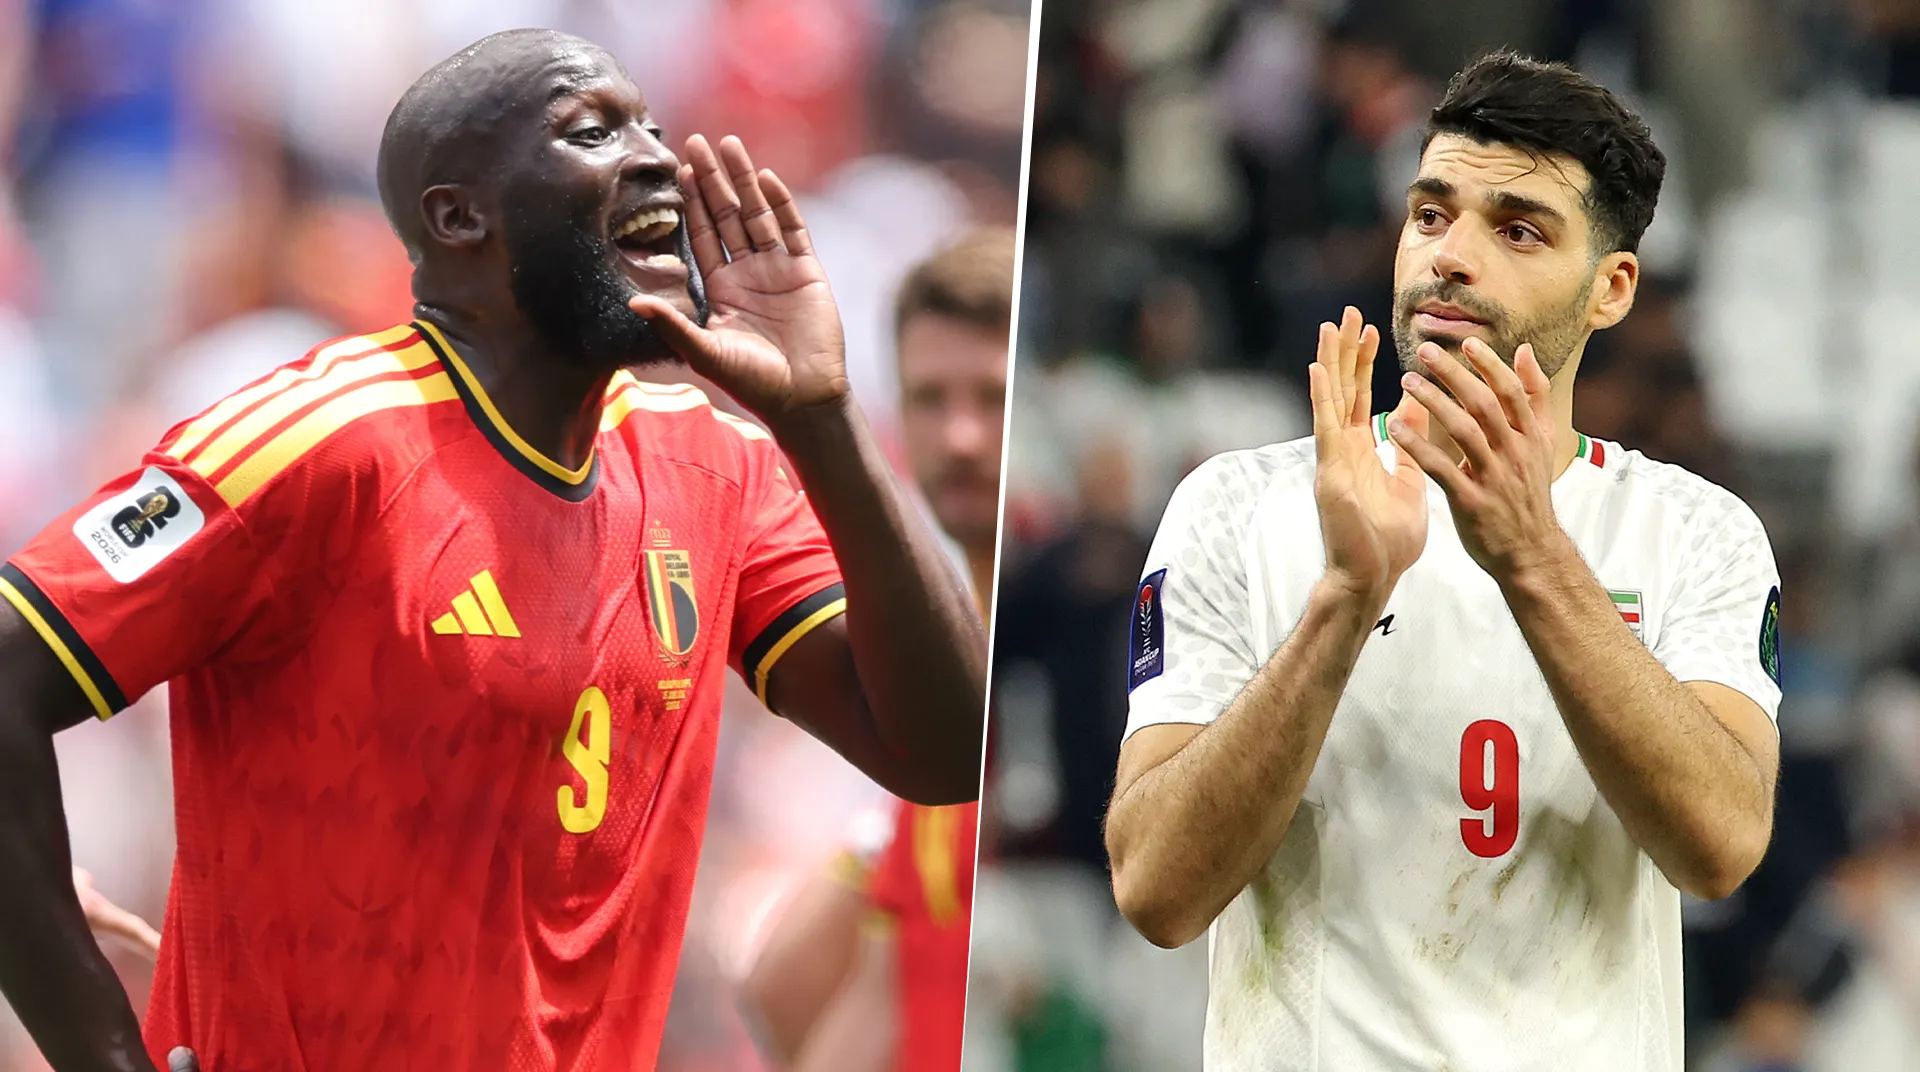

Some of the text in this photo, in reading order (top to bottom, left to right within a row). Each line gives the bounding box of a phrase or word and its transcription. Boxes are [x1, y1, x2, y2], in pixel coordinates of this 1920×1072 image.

[91, 531, 121, 564] 2026
[100, 527, 119, 547] WORLD
[118, 523, 136, 542] FIFA
[557, 686, 611, 834] 9
[1459, 719, 1519, 858] 9
